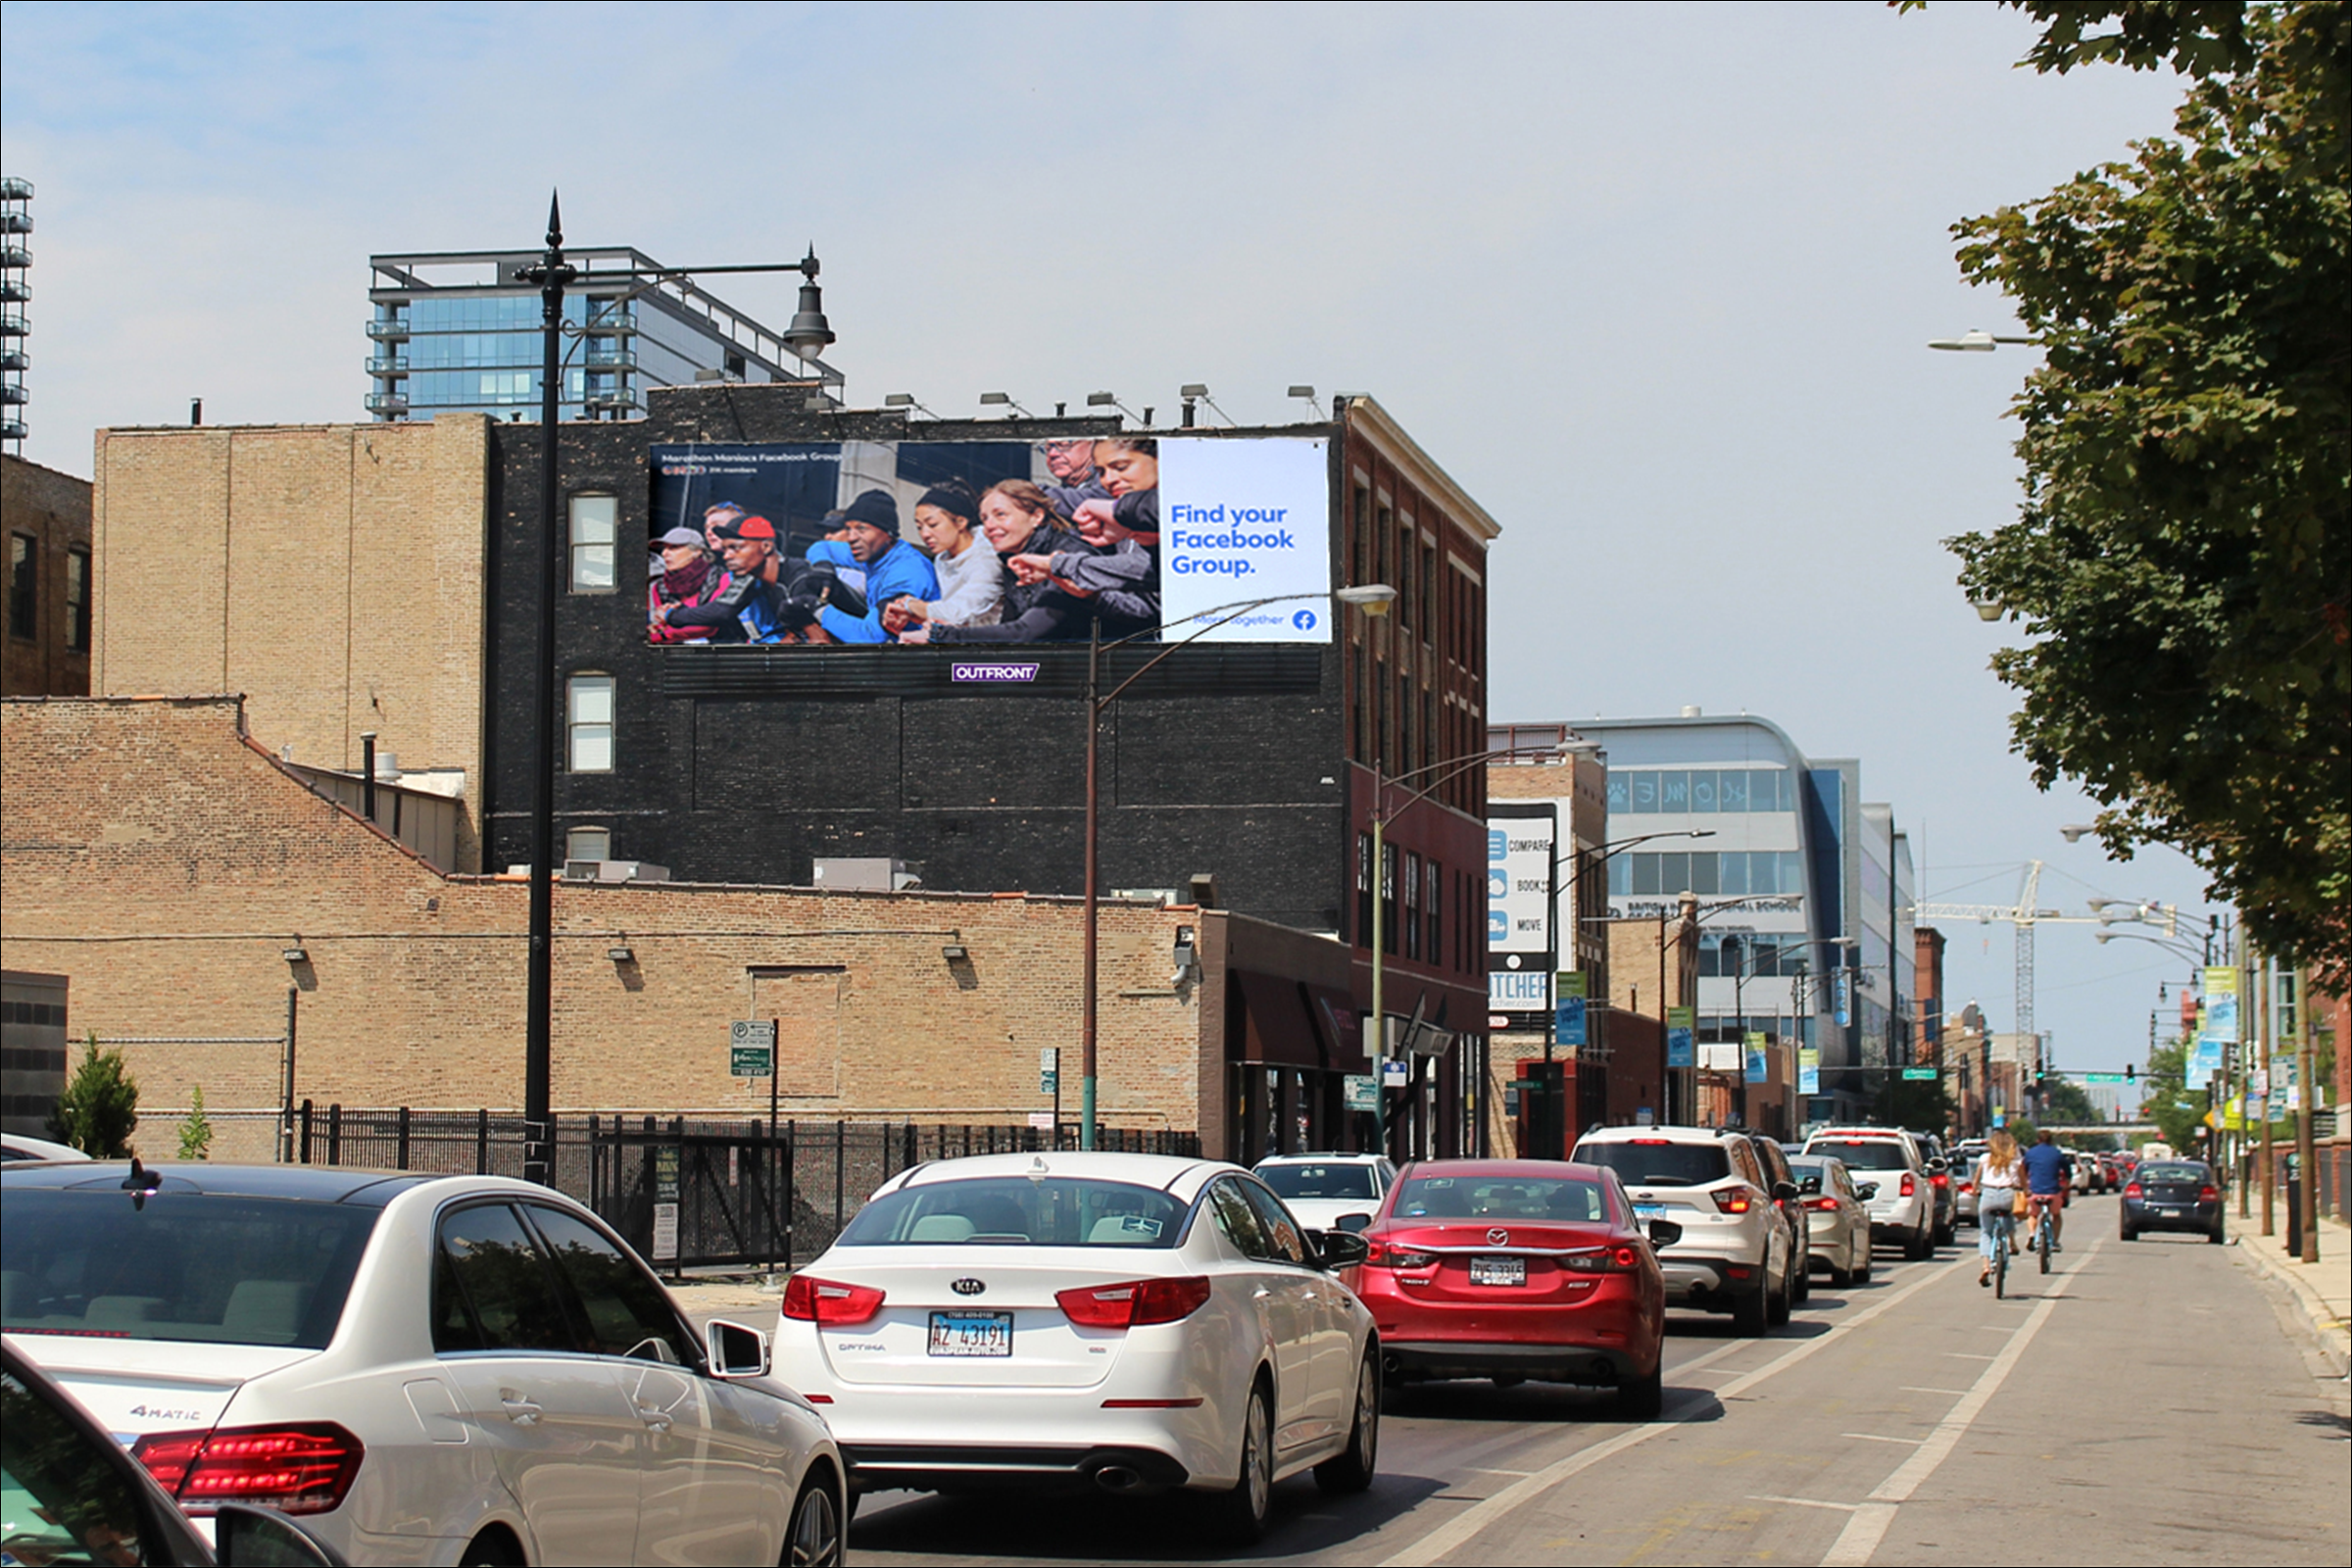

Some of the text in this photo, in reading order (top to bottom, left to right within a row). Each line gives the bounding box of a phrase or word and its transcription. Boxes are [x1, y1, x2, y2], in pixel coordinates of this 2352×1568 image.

[662, 452, 843, 463] Marathon Maniacs Facebook Group
[1171, 504, 1288, 528] Find your
[1171, 529, 1295, 549] Facebook
[1171, 555, 1256, 579] Group.
[1194, 613, 1285, 627] More together
[956, 666, 1034, 679] OUTFRONT
[1508, 839, 1550, 852] COMPARE
[1517, 879, 1540, 892] BOOK
[1517, 918, 1542, 931] MOVE
[956, 1281, 980, 1293] KIA
[932, 1324, 1005, 1347] AZ 43191
[838, 1343, 886, 1351] OPTIMA
[129, 1404, 201, 1421] 4MATIC
